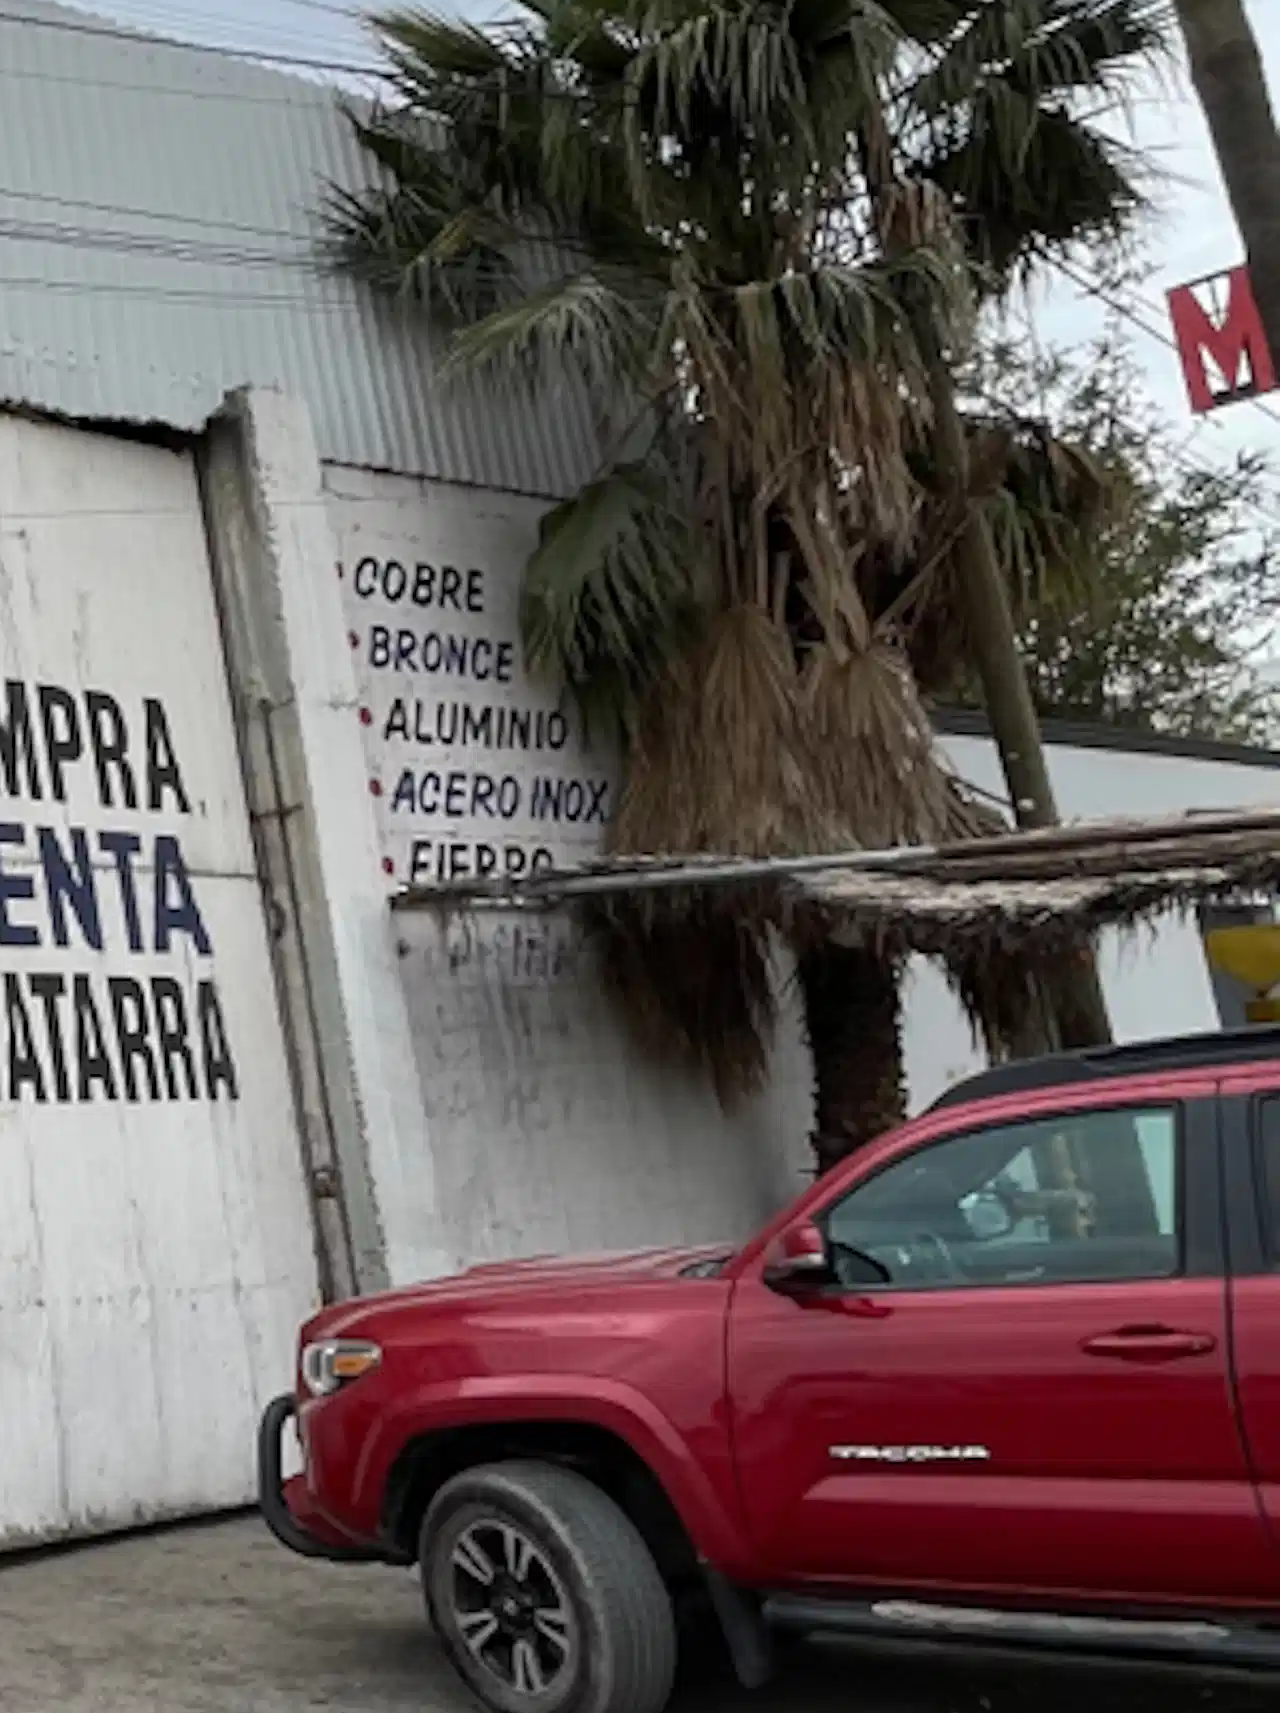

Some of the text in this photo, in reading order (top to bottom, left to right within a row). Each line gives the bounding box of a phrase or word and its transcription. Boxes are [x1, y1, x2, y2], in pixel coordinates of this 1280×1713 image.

[354, 557, 484, 612] COBRE
[370, 626, 513, 682] BRONCE
[384, 699, 567, 750] ALUMINIO
[391, 768, 609, 823] ACERO INOX
[828, 1445, 991, 1462] TACOMA
